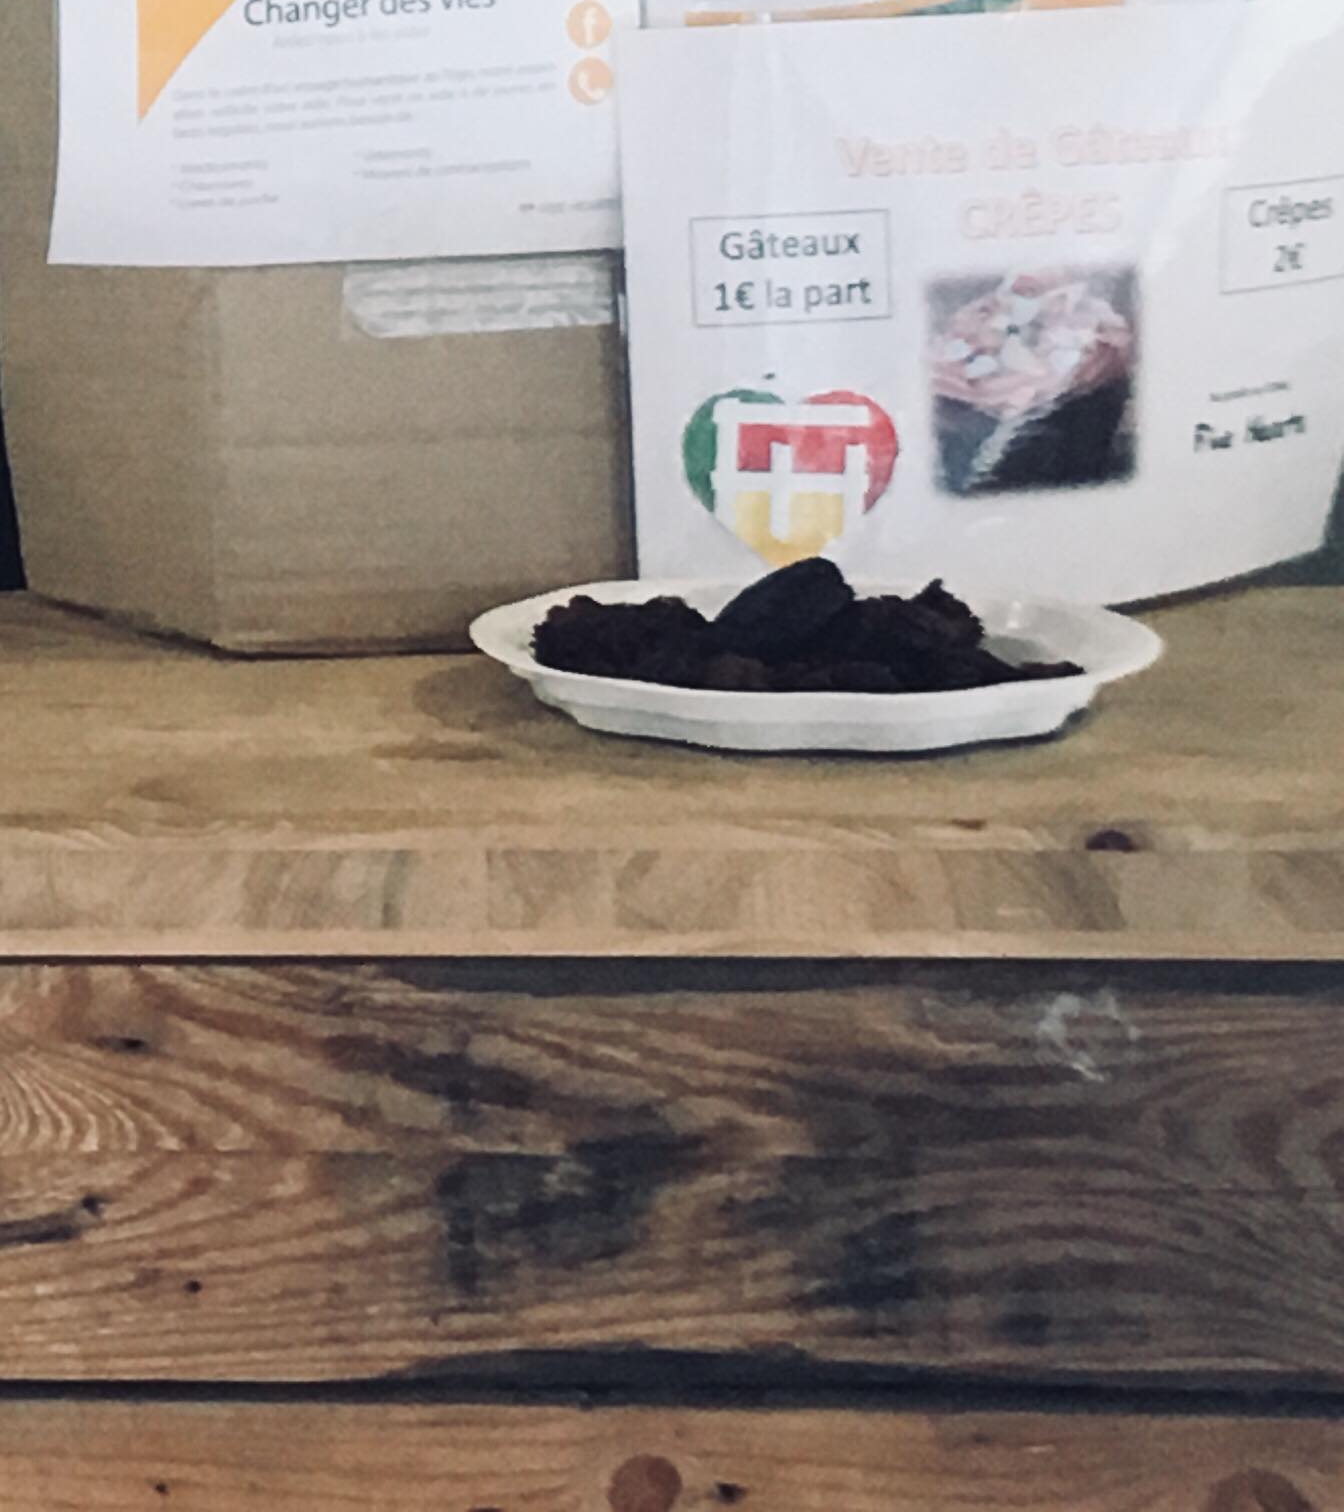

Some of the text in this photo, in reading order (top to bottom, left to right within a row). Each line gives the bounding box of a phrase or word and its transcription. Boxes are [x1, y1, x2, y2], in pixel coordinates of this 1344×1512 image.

[835, 135, 969, 178] Vente
[983, 125, 1040, 171] de
[719, 229, 861, 261] Gâteaux
[714, 277, 872, 313] 1€ la part
